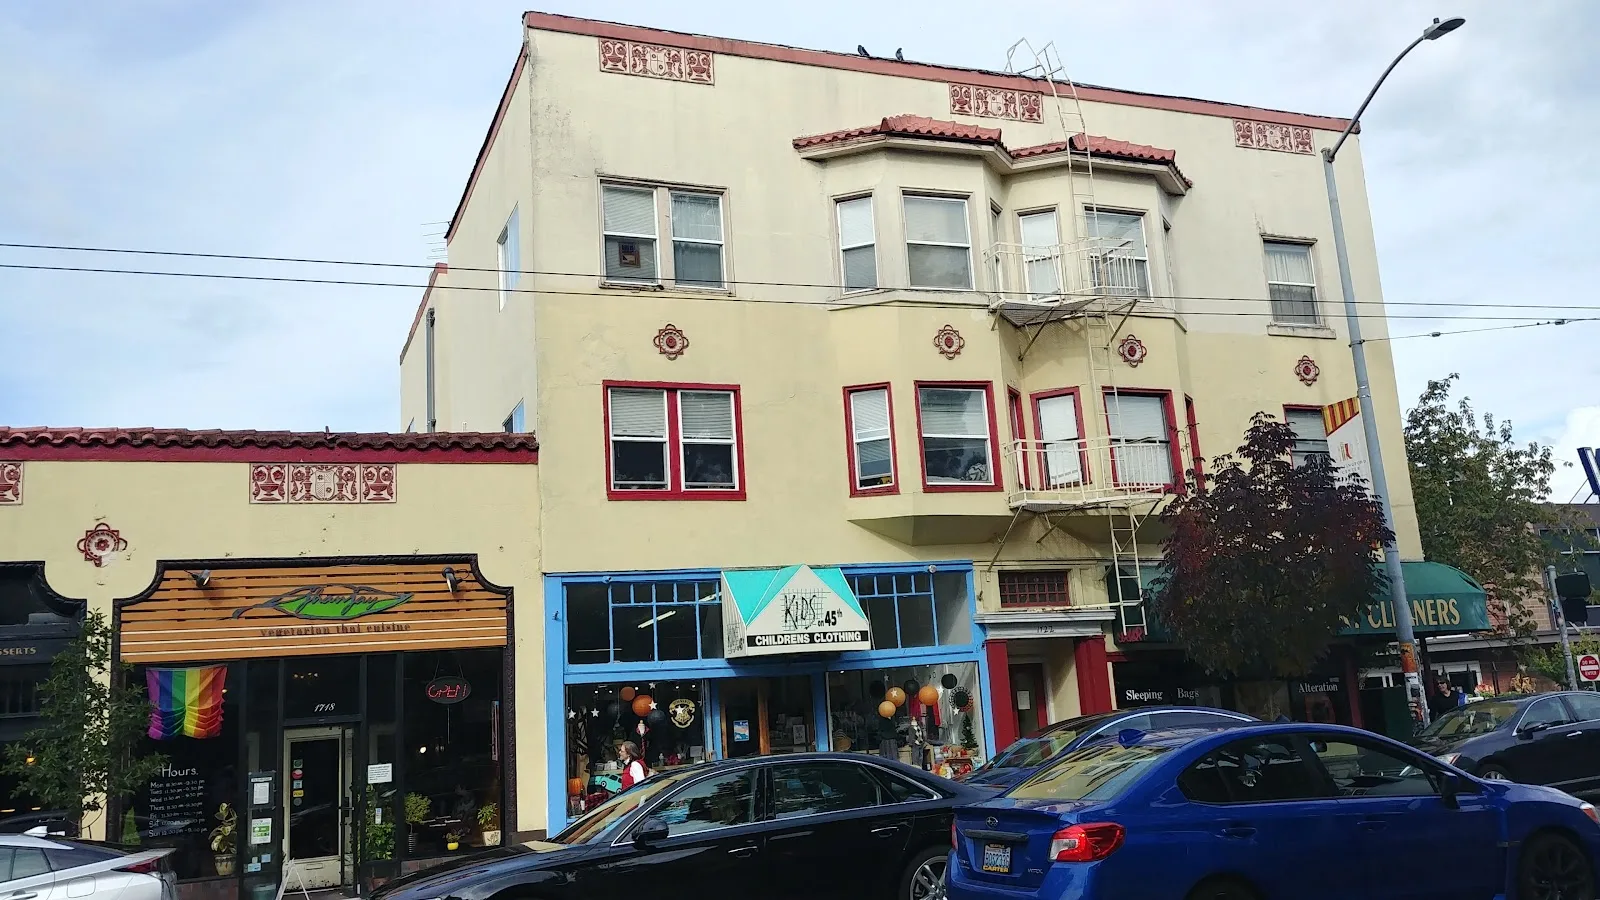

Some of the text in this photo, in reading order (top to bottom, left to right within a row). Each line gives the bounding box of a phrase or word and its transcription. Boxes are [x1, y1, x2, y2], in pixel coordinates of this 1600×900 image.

[784, 594, 817, 630] KIDS
[1366, 598, 1460, 629] CLNERS
[260, 622, 411, 637] vegetarian thai cuisine
[755, 631, 862, 646] CHILDRENS CLOTHING
[1126, 688, 1200, 701] Sleeping Bags
[1299, 682, 1338, 693] Alteration
[314, 702, 336, 712] 1718
